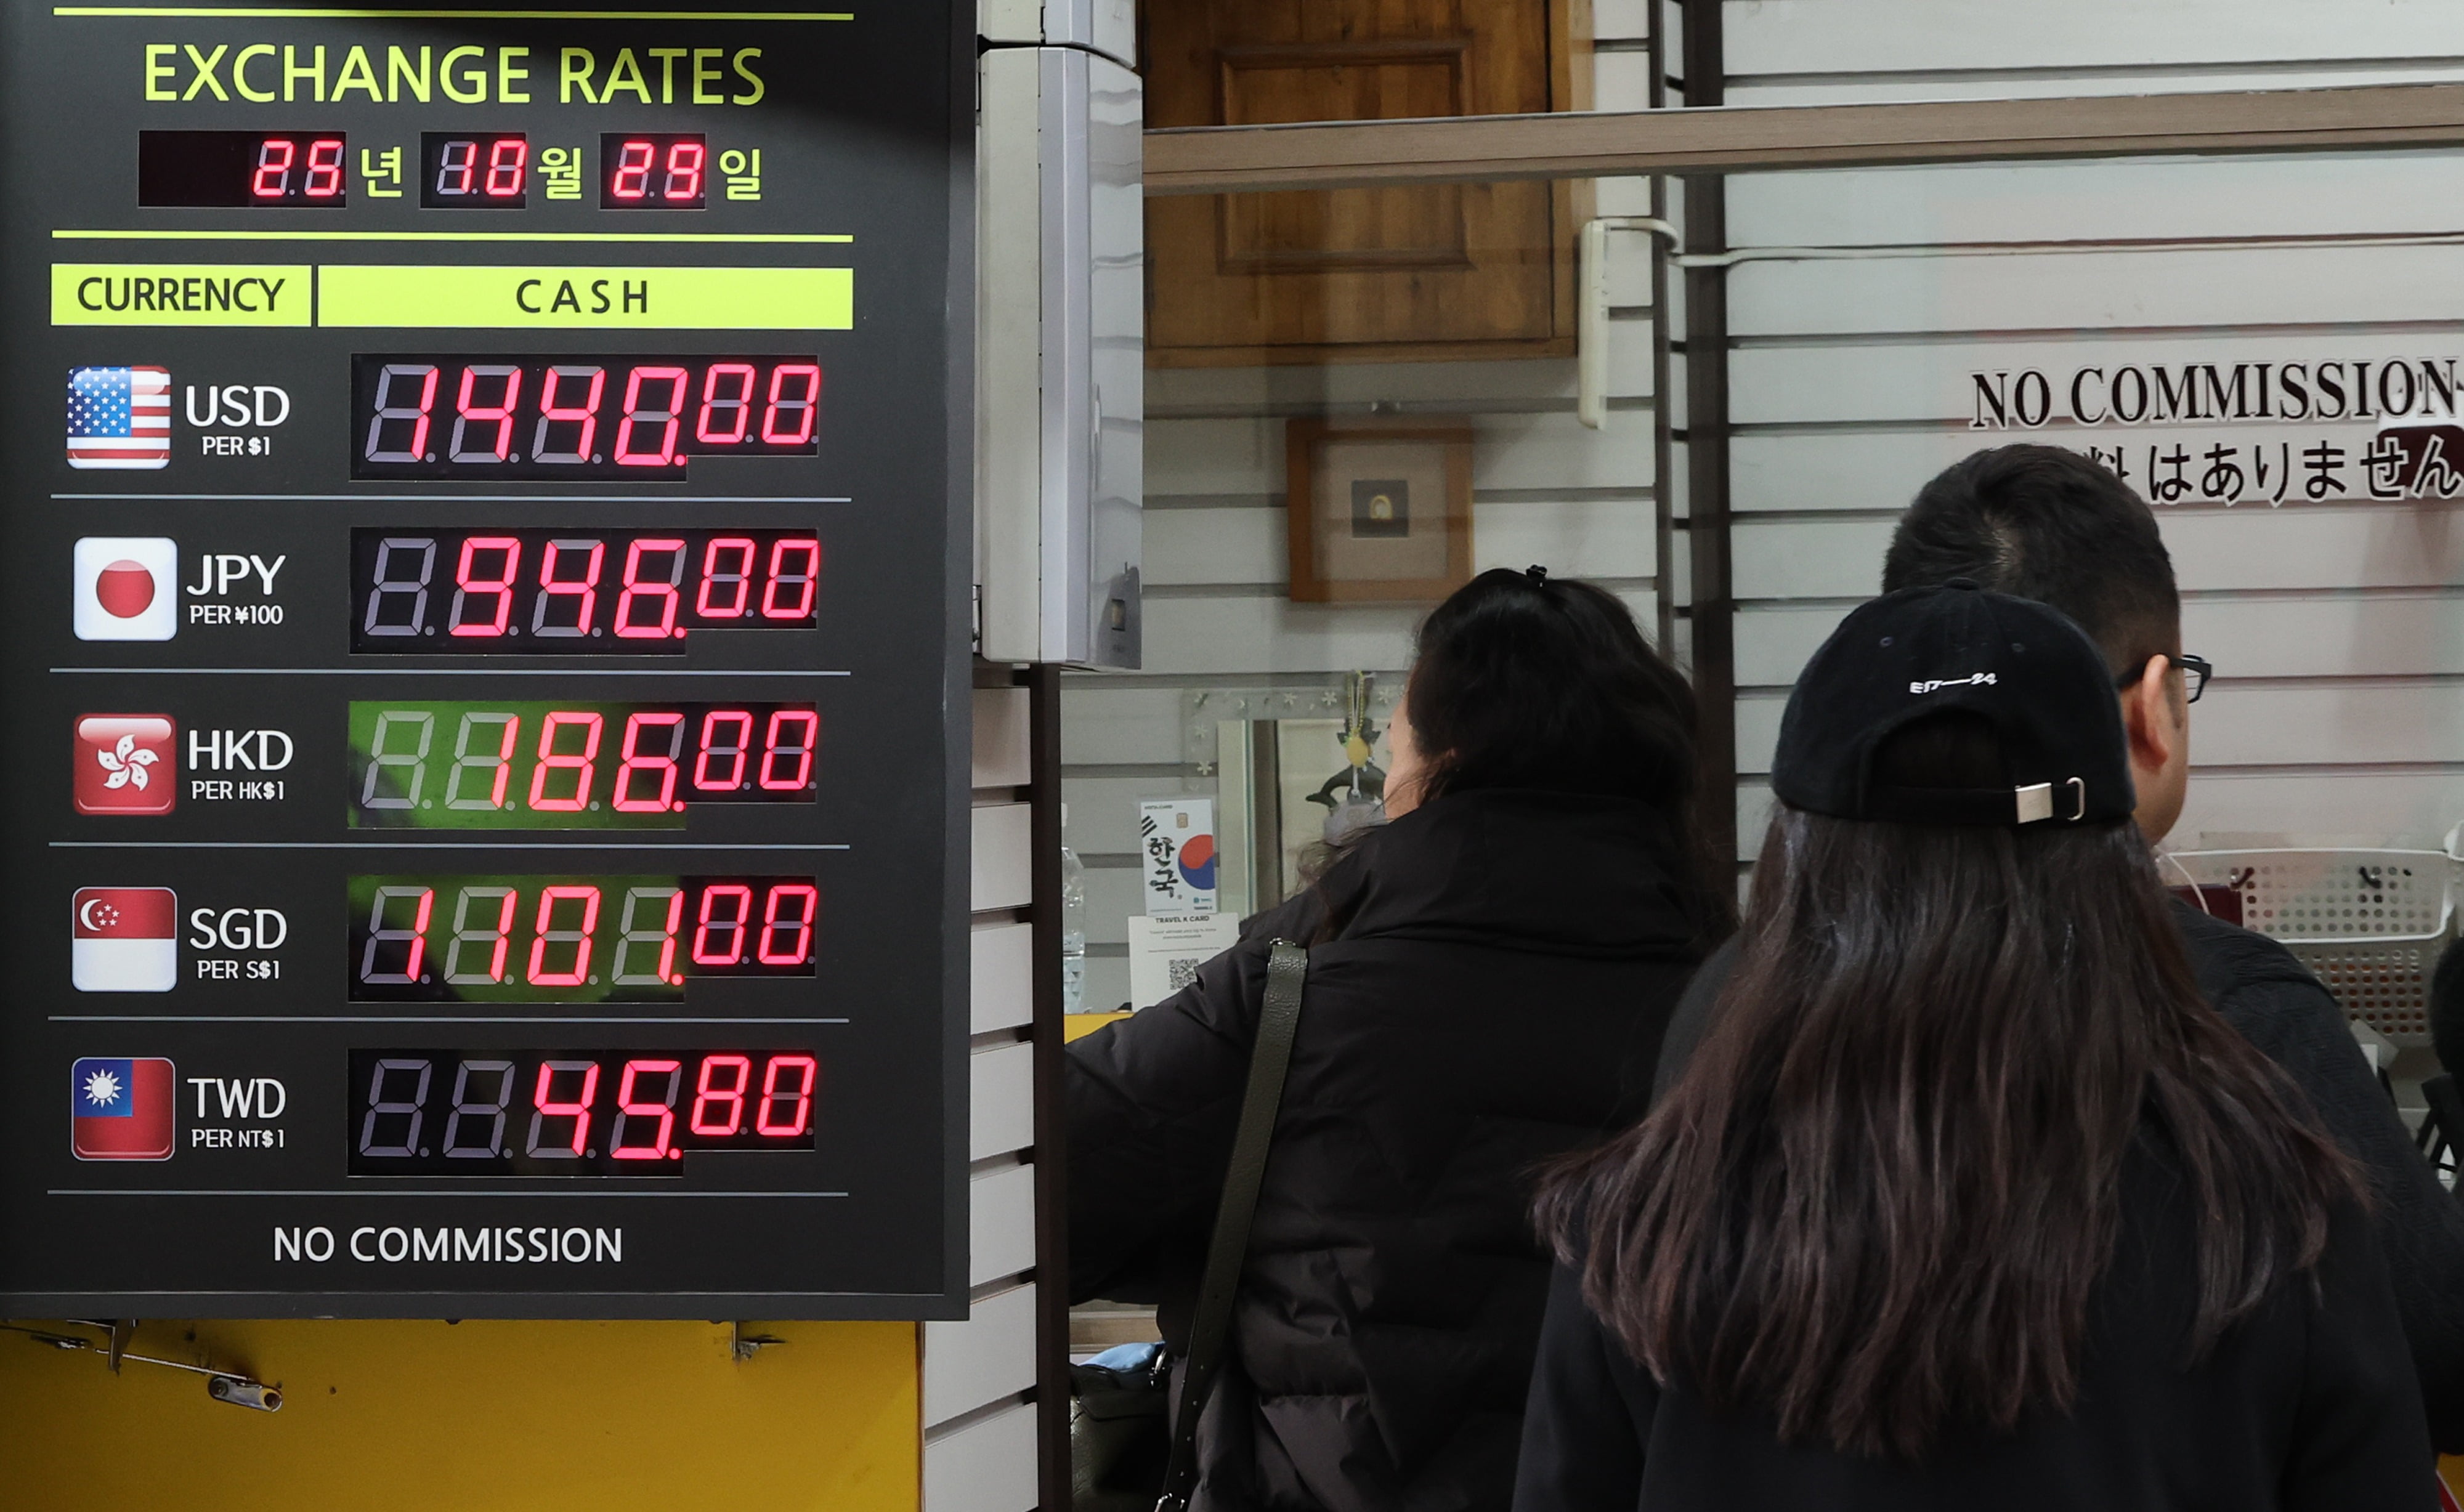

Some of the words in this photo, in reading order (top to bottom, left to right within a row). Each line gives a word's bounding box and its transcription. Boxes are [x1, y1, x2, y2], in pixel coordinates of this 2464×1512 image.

[146, 44, 530, 103] EXCHANGE
[561, 48, 764, 105] RATES
[253, 140, 342, 196] 25
[362, 147, 402, 197] 년
[460, 140, 529, 196] 10
[538, 148, 582, 199] 월
[613, 141, 705, 200] 29
[719, 149, 761, 200] 일
[78, 278, 285, 311] CURRENCY
[517, 280, 646, 313] CASH
[187, 386, 290, 427] USD
[1973, 371, 2050, 427] NO
[2072, 360, 2459, 423] COMMISSION
[202, 436, 243, 455] PER
[248, 437, 269, 455] $1
[187, 555, 286, 595] JPY
[190, 605, 231, 624] PER
[235, 605, 283, 624] ¥100
[189, 730, 293, 770] HKD
[192, 781, 232, 799] PER
[240, 781, 283, 799] HK$1
[190, 908, 286, 949] SGD
[197, 960, 238, 979] PER
[246, 961, 278, 979] S$1
[187, 1078, 285, 1118] TWD
[192, 1130, 232, 1147] PER
[275, 1227, 334, 1261] NO
[351, 1227, 621, 1262] COMMISSION
